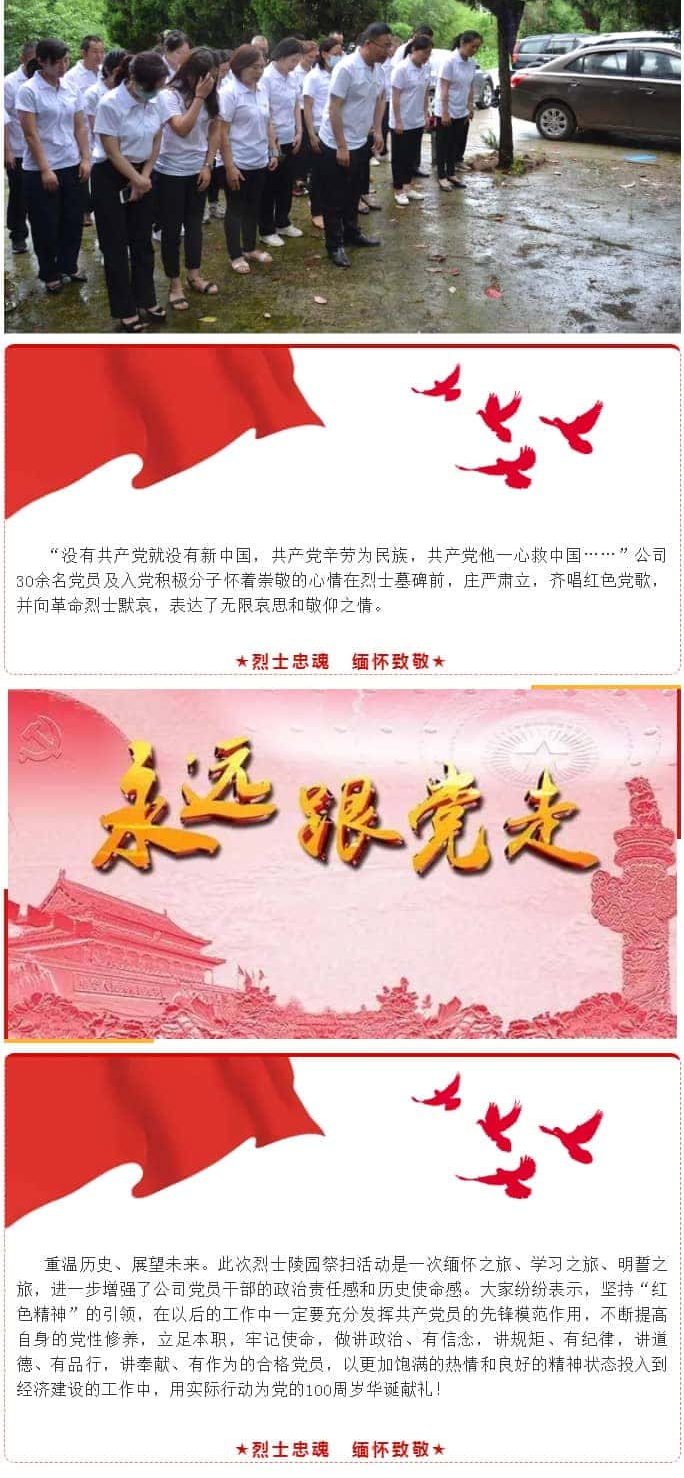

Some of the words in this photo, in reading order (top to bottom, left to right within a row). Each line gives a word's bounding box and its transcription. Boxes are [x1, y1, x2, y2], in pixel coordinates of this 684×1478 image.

[16, 596, 383, 614] 并向革命烈士默哀，表达了无限哀思和敬仰之情。
[252, 653, 329, 670] 烈士忠魂
[351, 653, 429, 670] 缅怀致敬
[92, 735, 600, 875] 永远跟党走
[252, 1441, 329, 1458] 烈士忠魂
[351, 1441, 429, 1458] 缅怀致敬
